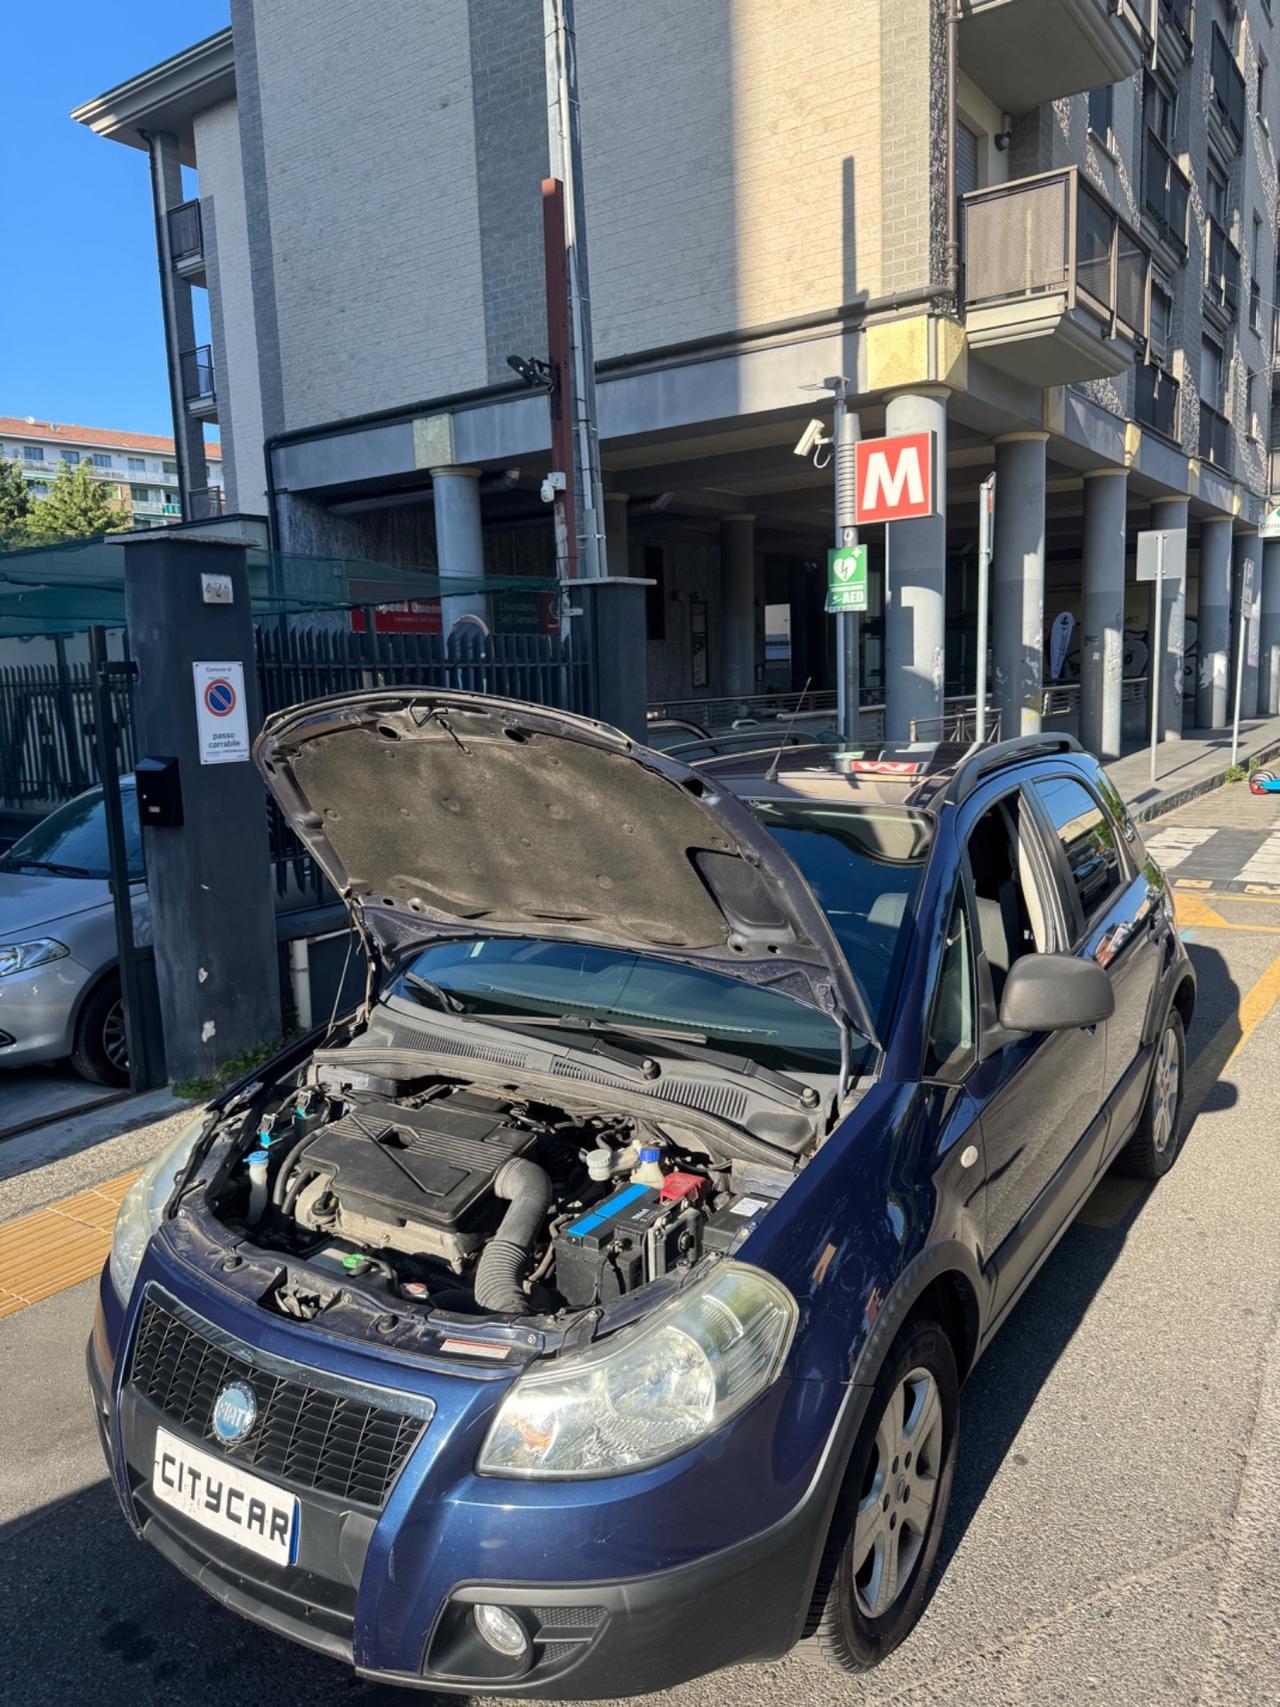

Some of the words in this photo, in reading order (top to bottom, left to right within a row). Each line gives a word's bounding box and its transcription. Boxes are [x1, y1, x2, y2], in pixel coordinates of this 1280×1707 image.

[862, 446, 925, 511] M
[842, 590, 864, 604] AED
[208, 740, 241, 750] carrabile
[212, 732, 236, 741] passo
[219, 1402, 247, 1428] FIAT
[161, 1452, 290, 1547] CITYCAR
